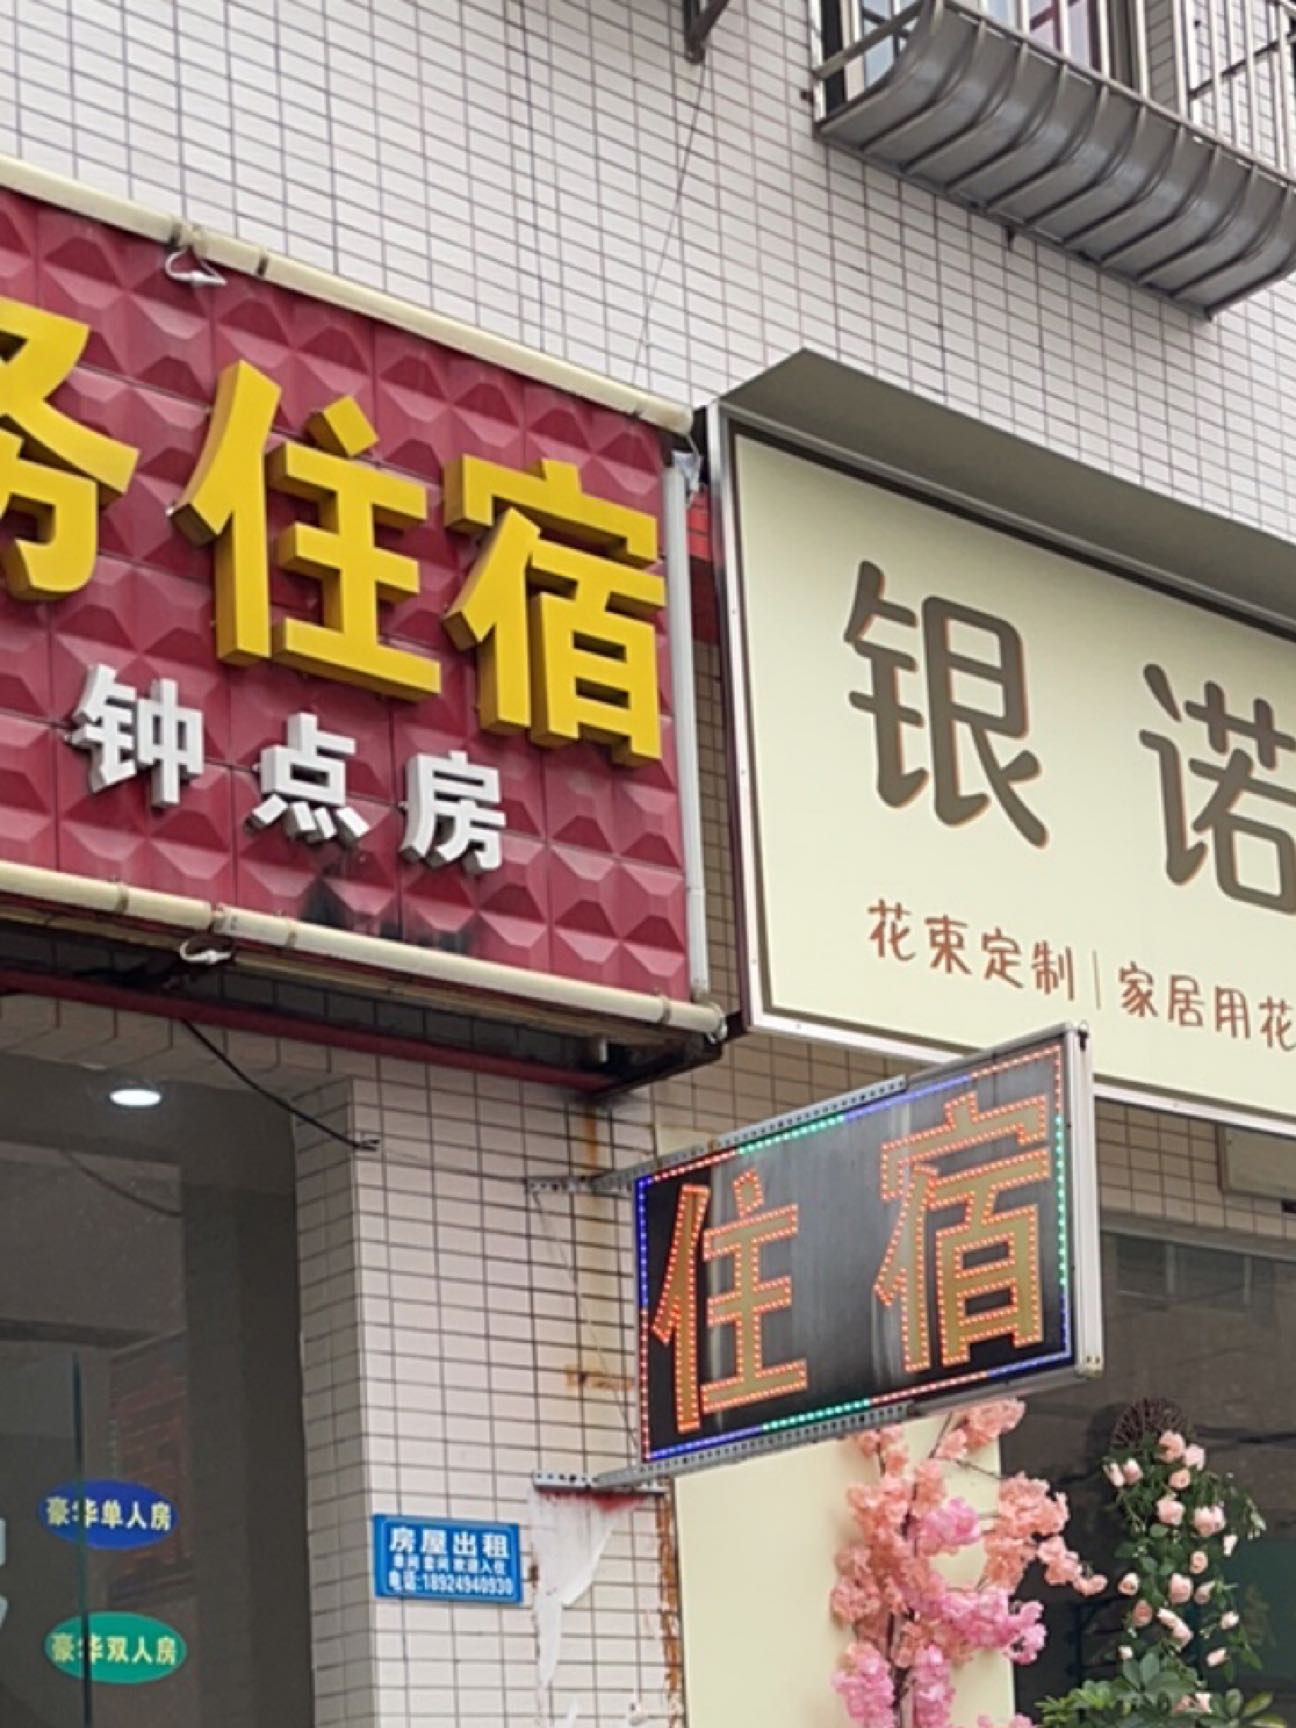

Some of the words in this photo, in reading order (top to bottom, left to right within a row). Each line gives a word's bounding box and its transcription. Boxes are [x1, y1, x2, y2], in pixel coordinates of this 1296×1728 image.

[66, 664, 506, 872] 钟点房
[867, 898, 1076, 1002] 花束定制
[1118, 940, 1296, 1053] 家居用花
[651, 1091, 1053, 1434] 住宿
[46, 1497, 172, 1531] 豪华单人房
[388, 1526, 509, 1559] 房屋出租
[50, 1633, 176, 1666] 豪华双人房
